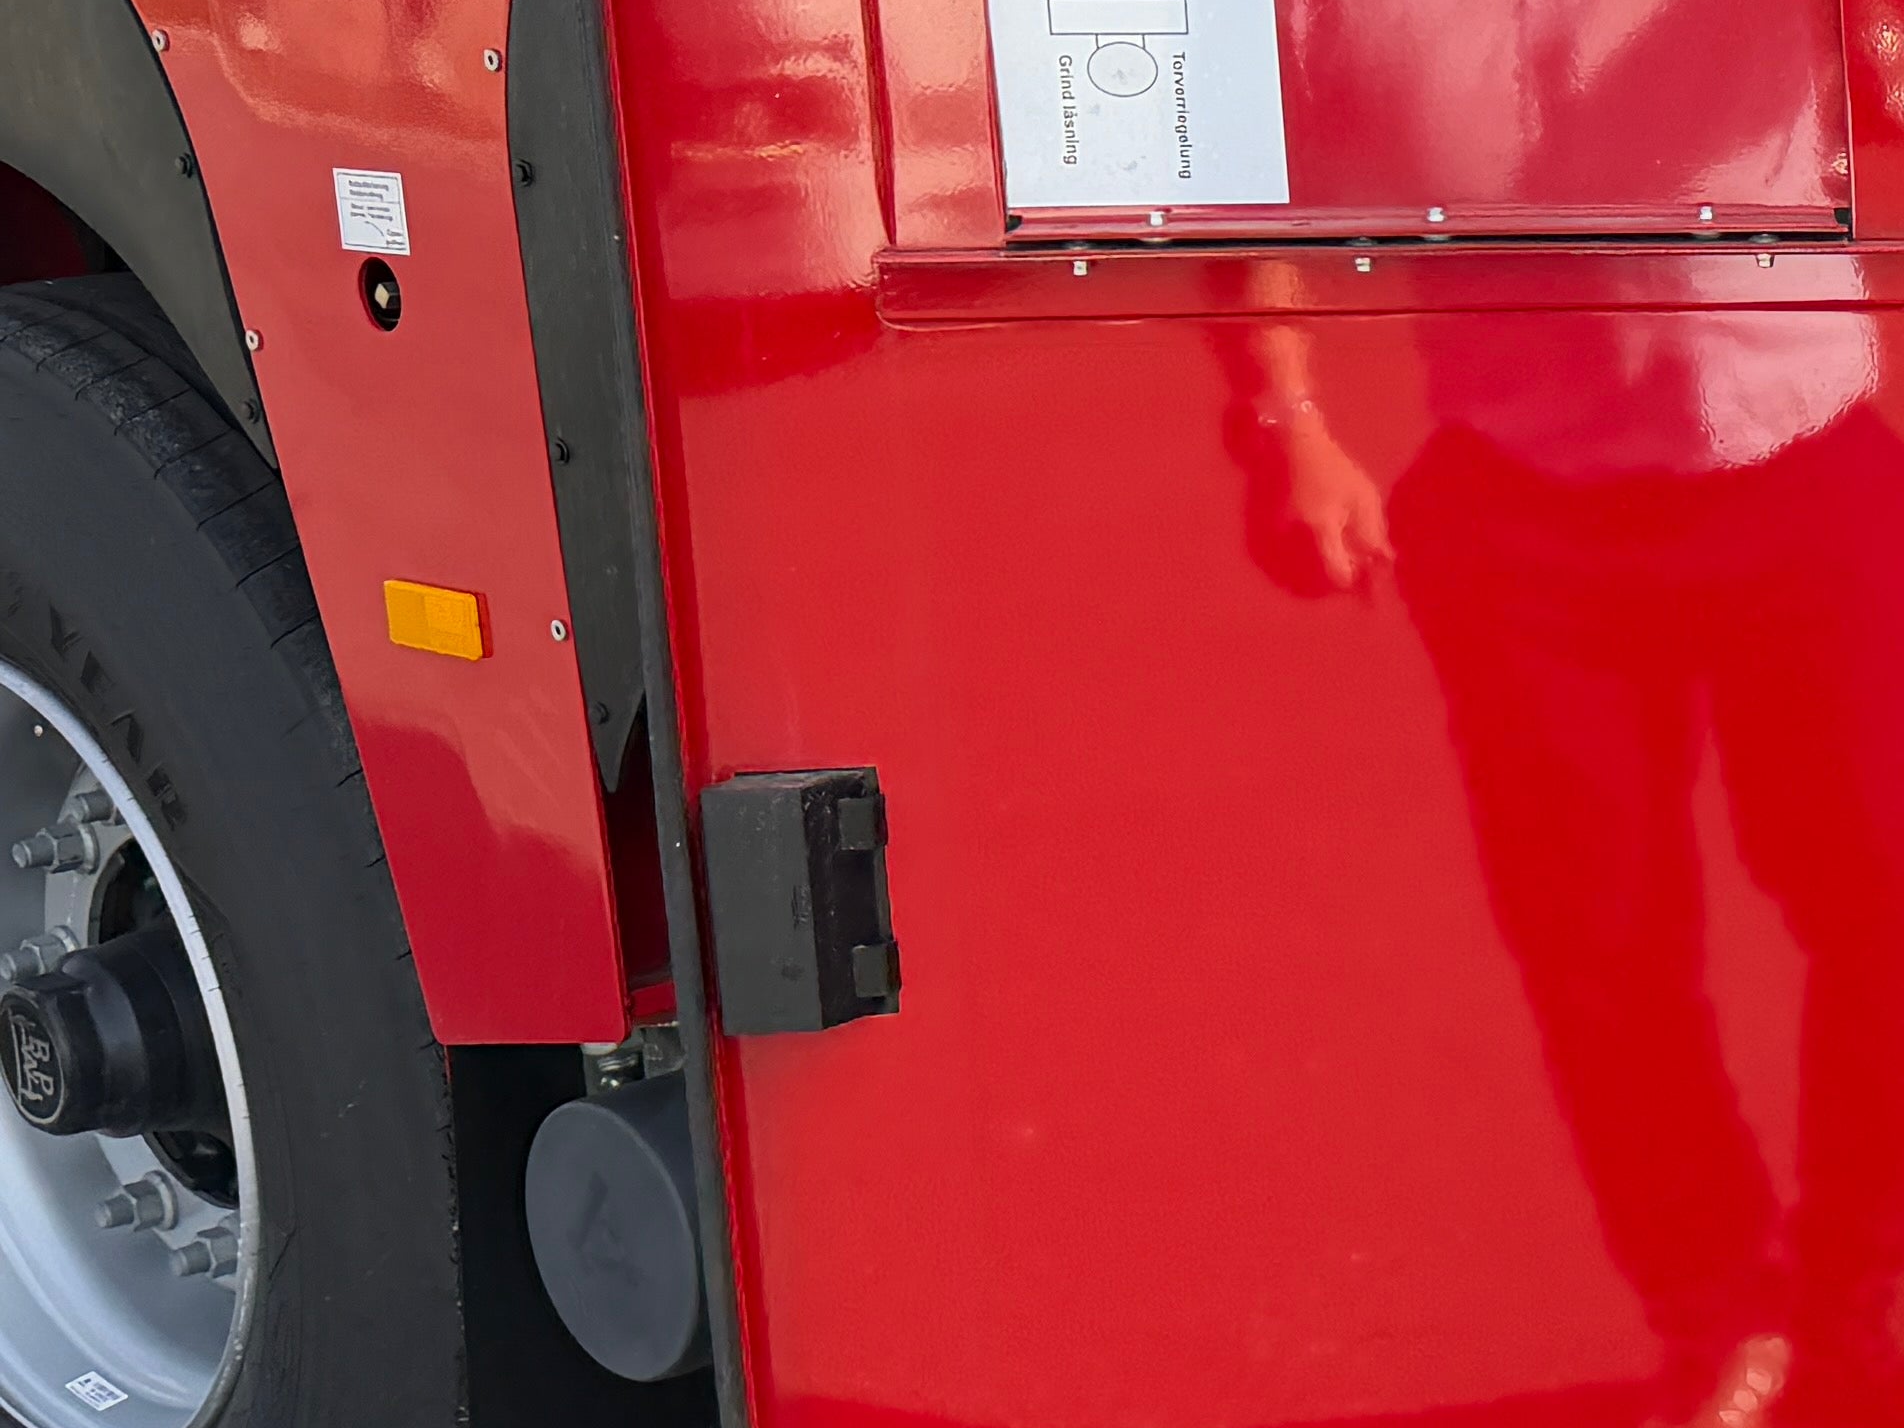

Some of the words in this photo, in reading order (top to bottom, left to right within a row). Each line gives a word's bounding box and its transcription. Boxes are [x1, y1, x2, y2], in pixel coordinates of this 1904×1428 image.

[1058, 54, 1076, 100] Grind
[1062, 105, 1080, 165] låsning
[1172, 51, 1193, 179] Torverriegelung
